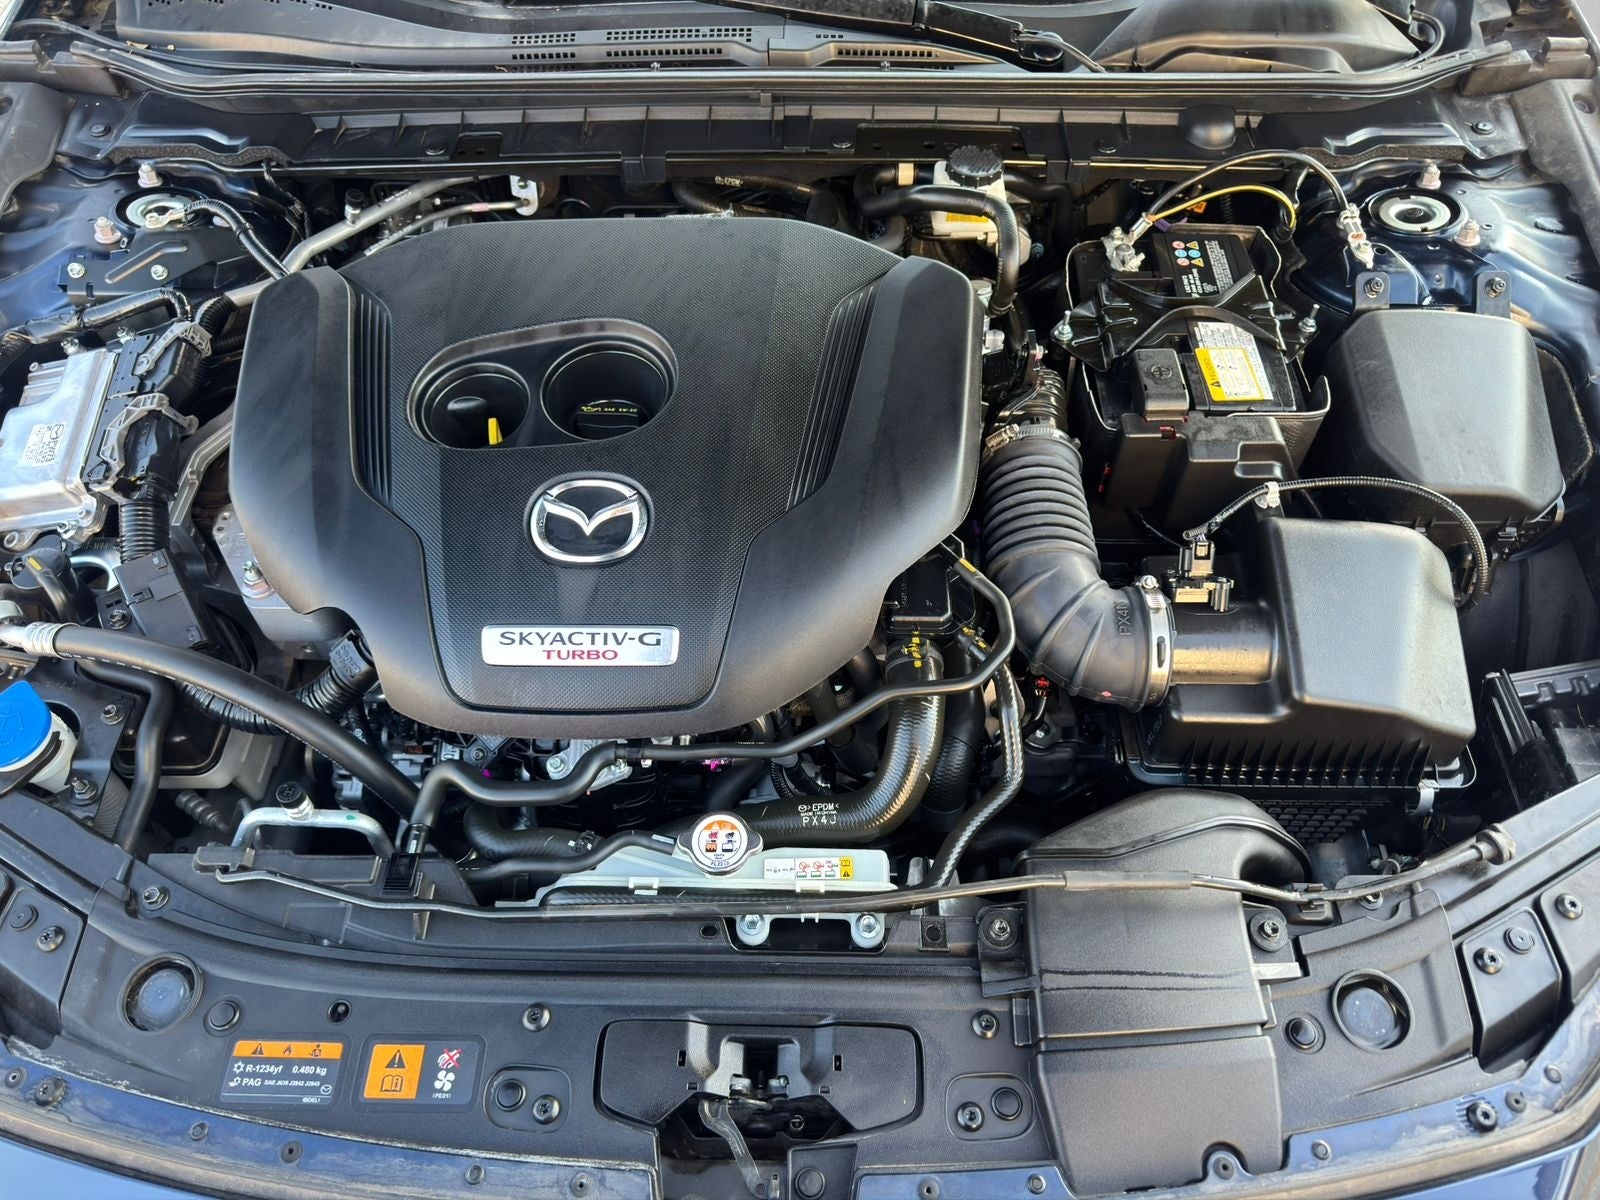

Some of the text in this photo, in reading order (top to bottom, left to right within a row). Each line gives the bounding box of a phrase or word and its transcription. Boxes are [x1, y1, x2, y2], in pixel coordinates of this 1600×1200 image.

[1116, 599, 1132, 635] PX4N
[499, 631, 662, 646] SKYACTIV-G
[542, 649, 618, 661] TURBO
[245, 1064, 327, 1076] R-1234yf 0.480 kg
[242, 1078, 261, 1086] PAG
